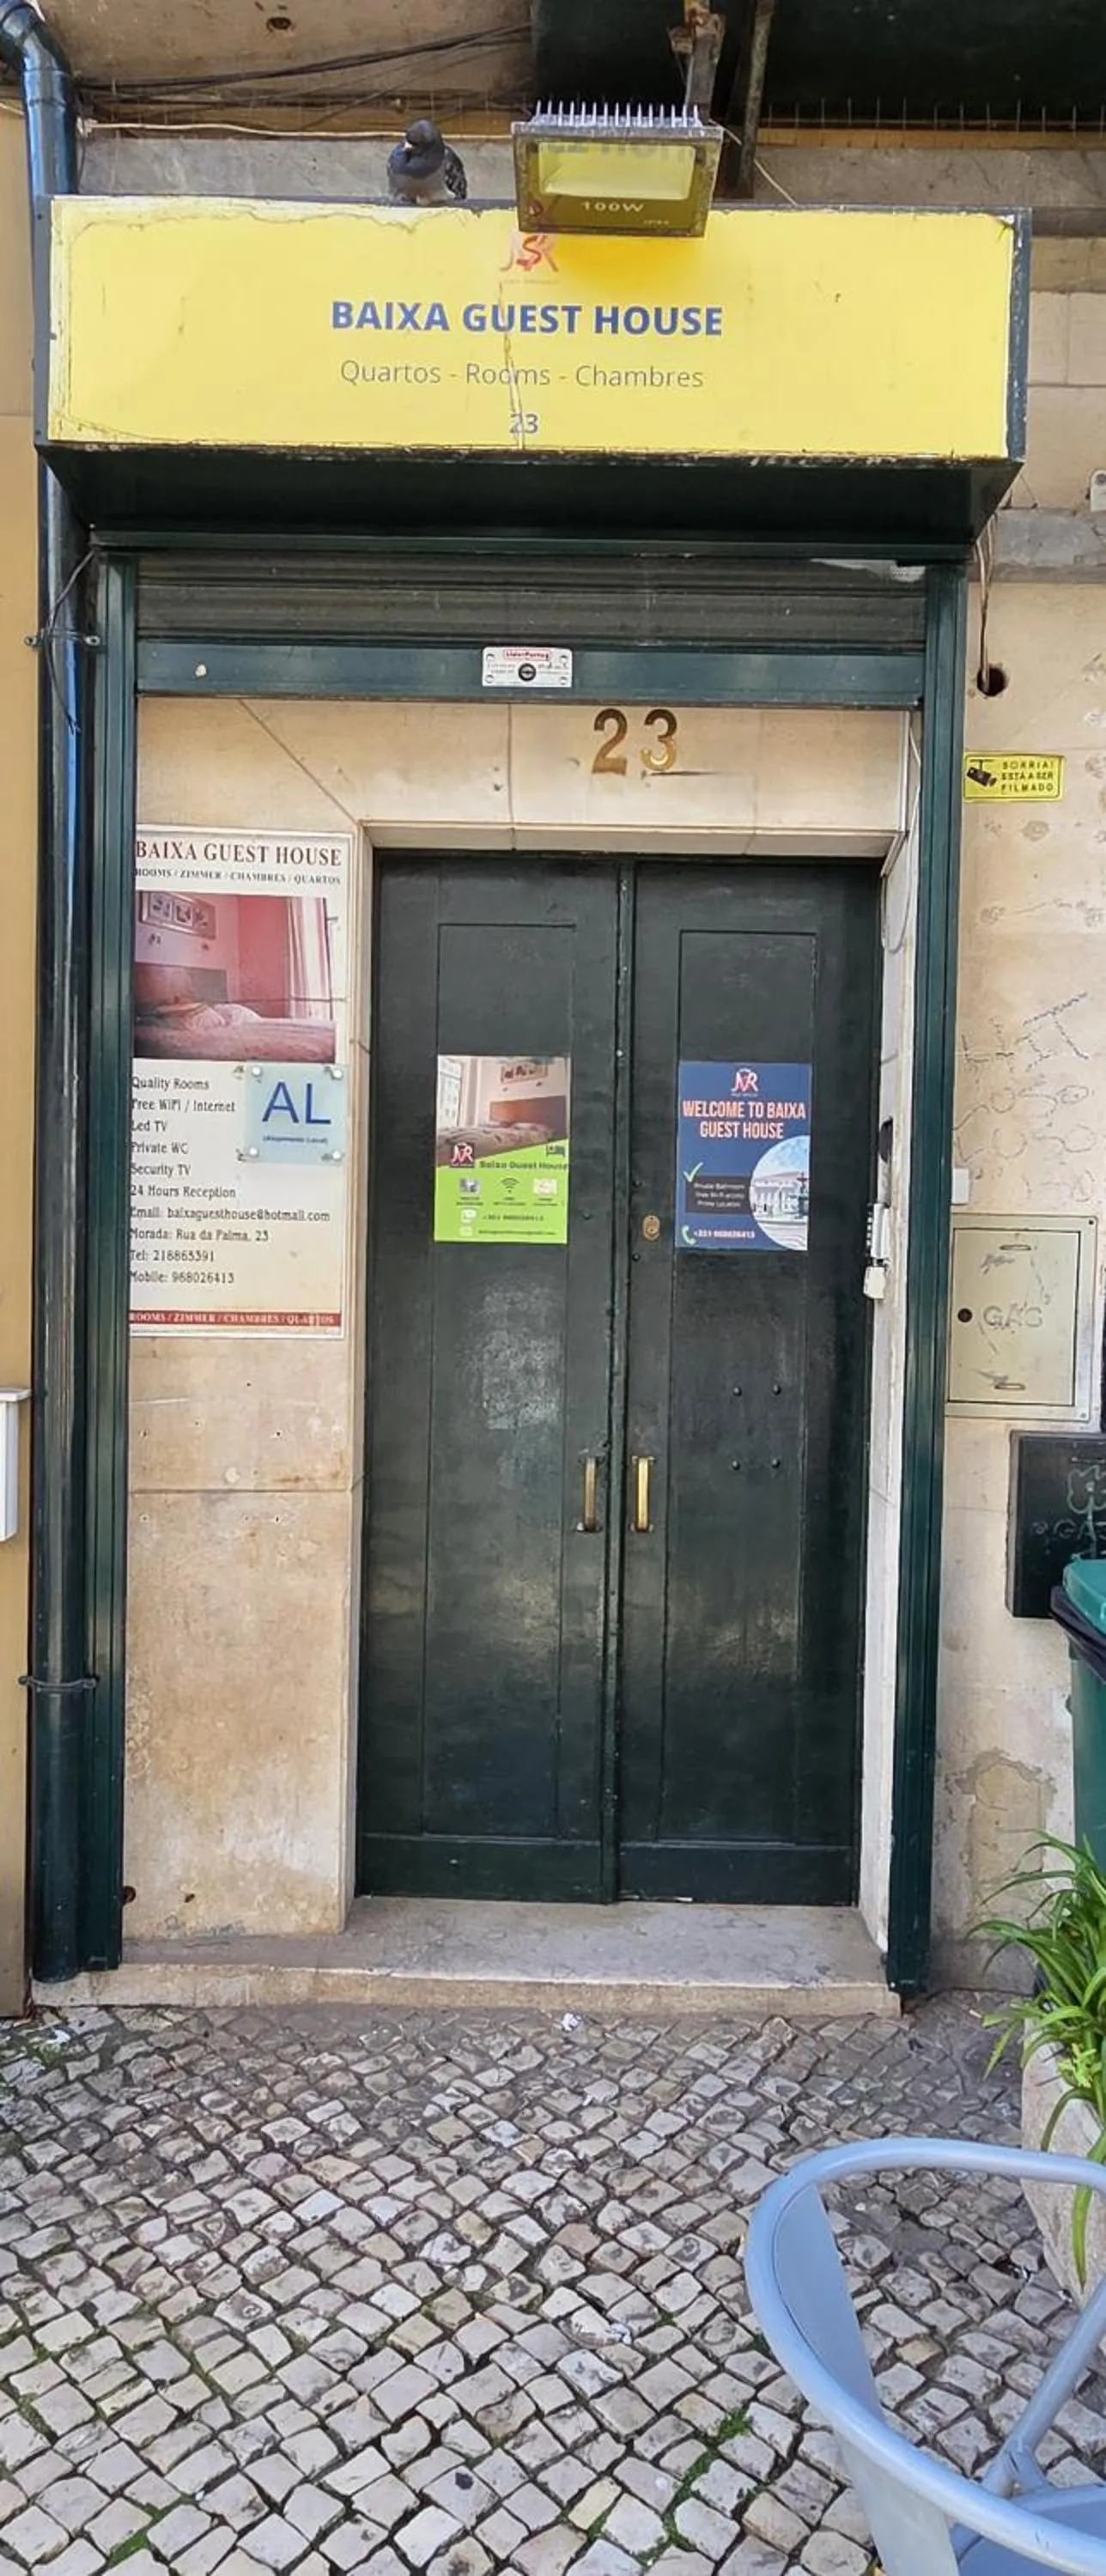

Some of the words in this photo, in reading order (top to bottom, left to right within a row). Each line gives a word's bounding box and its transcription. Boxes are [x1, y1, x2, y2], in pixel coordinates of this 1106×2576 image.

[581, 200, 644, 213] 100W
[331, 301, 450, 331] BAIXA
[463, 303, 582, 333] GUEST
[594, 306, 723, 336] HOUSE
[341, 359, 441, 385] Quartos
[465, 363, 551, 386] Rooms
[576, 365, 704, 388] Chambres
[509, 412, 539, 434] 23
[592, 708, 678, 776] 23
[1001, 782, 1054, 793] FILMADO
[136, 840, 198, 860] BAIXA
[204, 843, 270, 865] GUEST
[276, 846, 343, 867] HOUSE
[180, 870, 222, 879] ZIMMER
[230, 872, 286, 883] CHAMBRES
[294, 874, 342, 885] QUARTOS
[131, 1076, 171, 1092] Quality
[173, 1078, 210, 1091] Rooms
[131, 1098, 155, 1110] Free
[192, 1101, 235, 1113] Internet
[262, 1081, 331, 1125] AL
[682, 1099, 745, 1118] WELCOME
[749, 1101, 764, 1118] TO
[767, 1102, 806, 1120] BAIXA
[131, 1119, 150, 1132] Led
[155, 1120, 167, 1133] TV
[700, 1121, 738, 1139] GUEST
[743, 1121, 785, 1139] HOUSE
[131, 1140, 167, 1155] Private
[171, 1141, 189, 1155] WC
[131, 1162, 173, 1178] Security
[178, 1163, 191, 1176] TV
[131, 1184, 143, 1196] 24
[148, 1184, 179, 1197] Hours
[183, 1185, 236, 1200] Reception
[175, 1227, 197, 1240] Rua
[198, 1229, 212, 1241] da
[254, 1230, 270, 1242] 23
